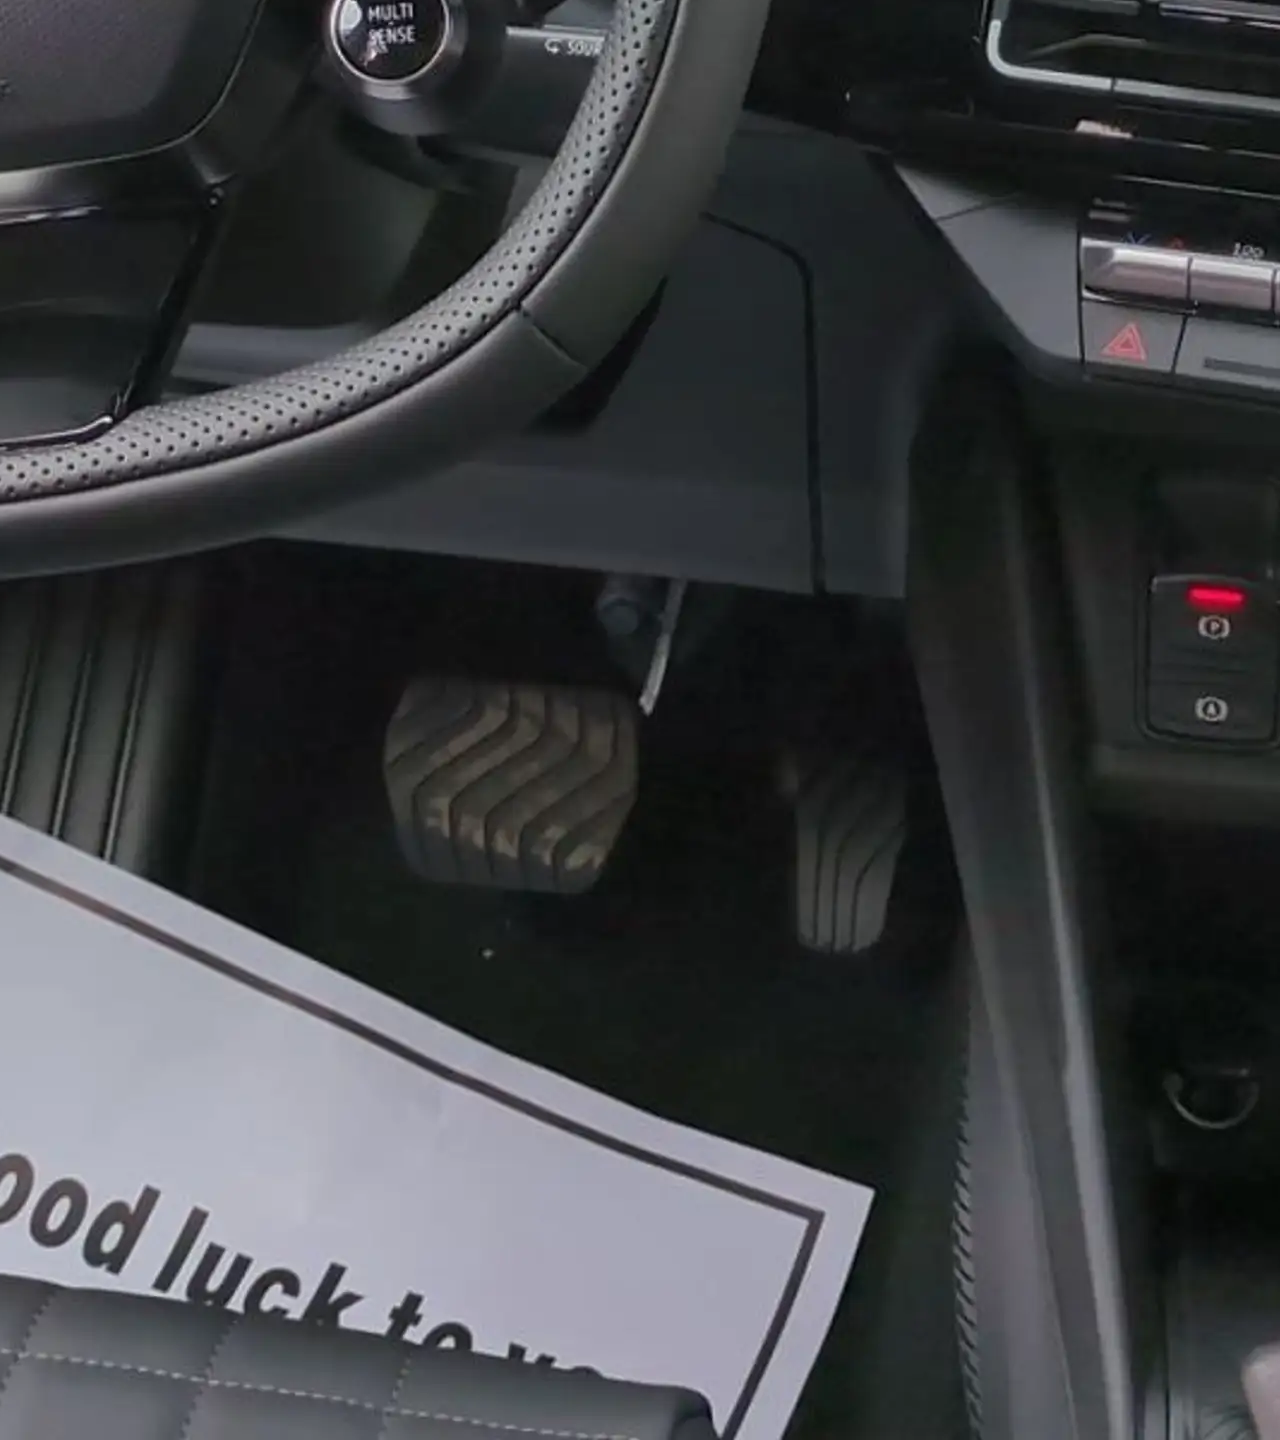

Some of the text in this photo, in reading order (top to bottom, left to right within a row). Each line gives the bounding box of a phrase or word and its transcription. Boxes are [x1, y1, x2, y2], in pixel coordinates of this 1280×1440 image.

[368, 3, 414, 21] MULTI
[369, 26, 416, 45] SENSE
[152, 1206, 364, 1328] luck
